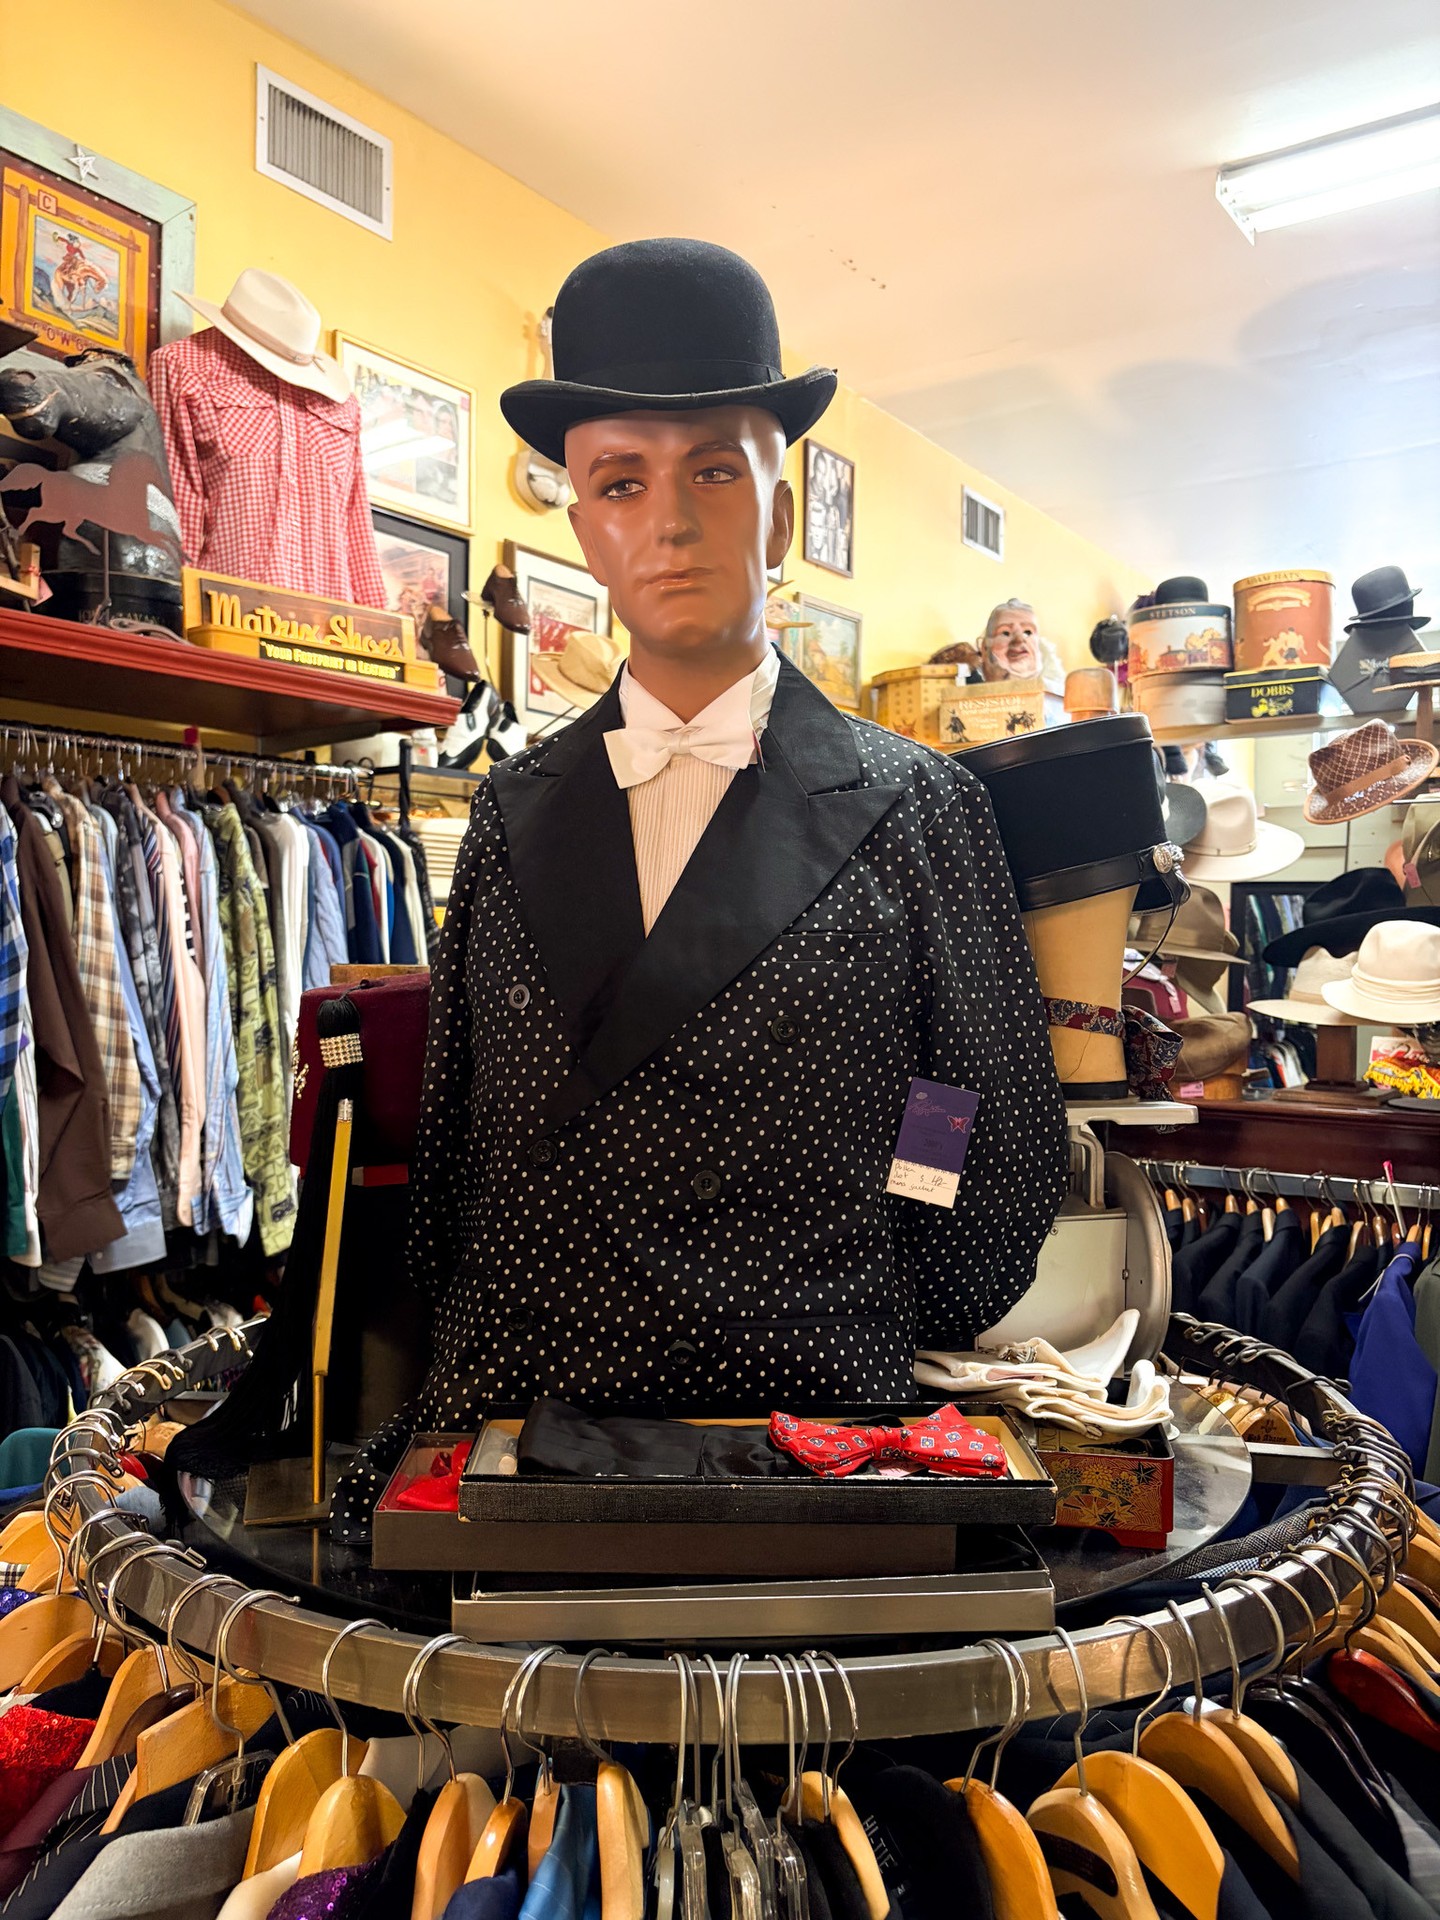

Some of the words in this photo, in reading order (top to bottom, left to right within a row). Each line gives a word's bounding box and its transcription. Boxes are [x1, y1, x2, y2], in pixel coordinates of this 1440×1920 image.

[1150, 607, 1197, 618] STETSON
[207, 591, 322, 642] Matrix
[322, 614, 405, 658] Shoes
[293, 648, 345, 671] FOOTPRINT
[1251, 685, 1295, 698] DOBBS
